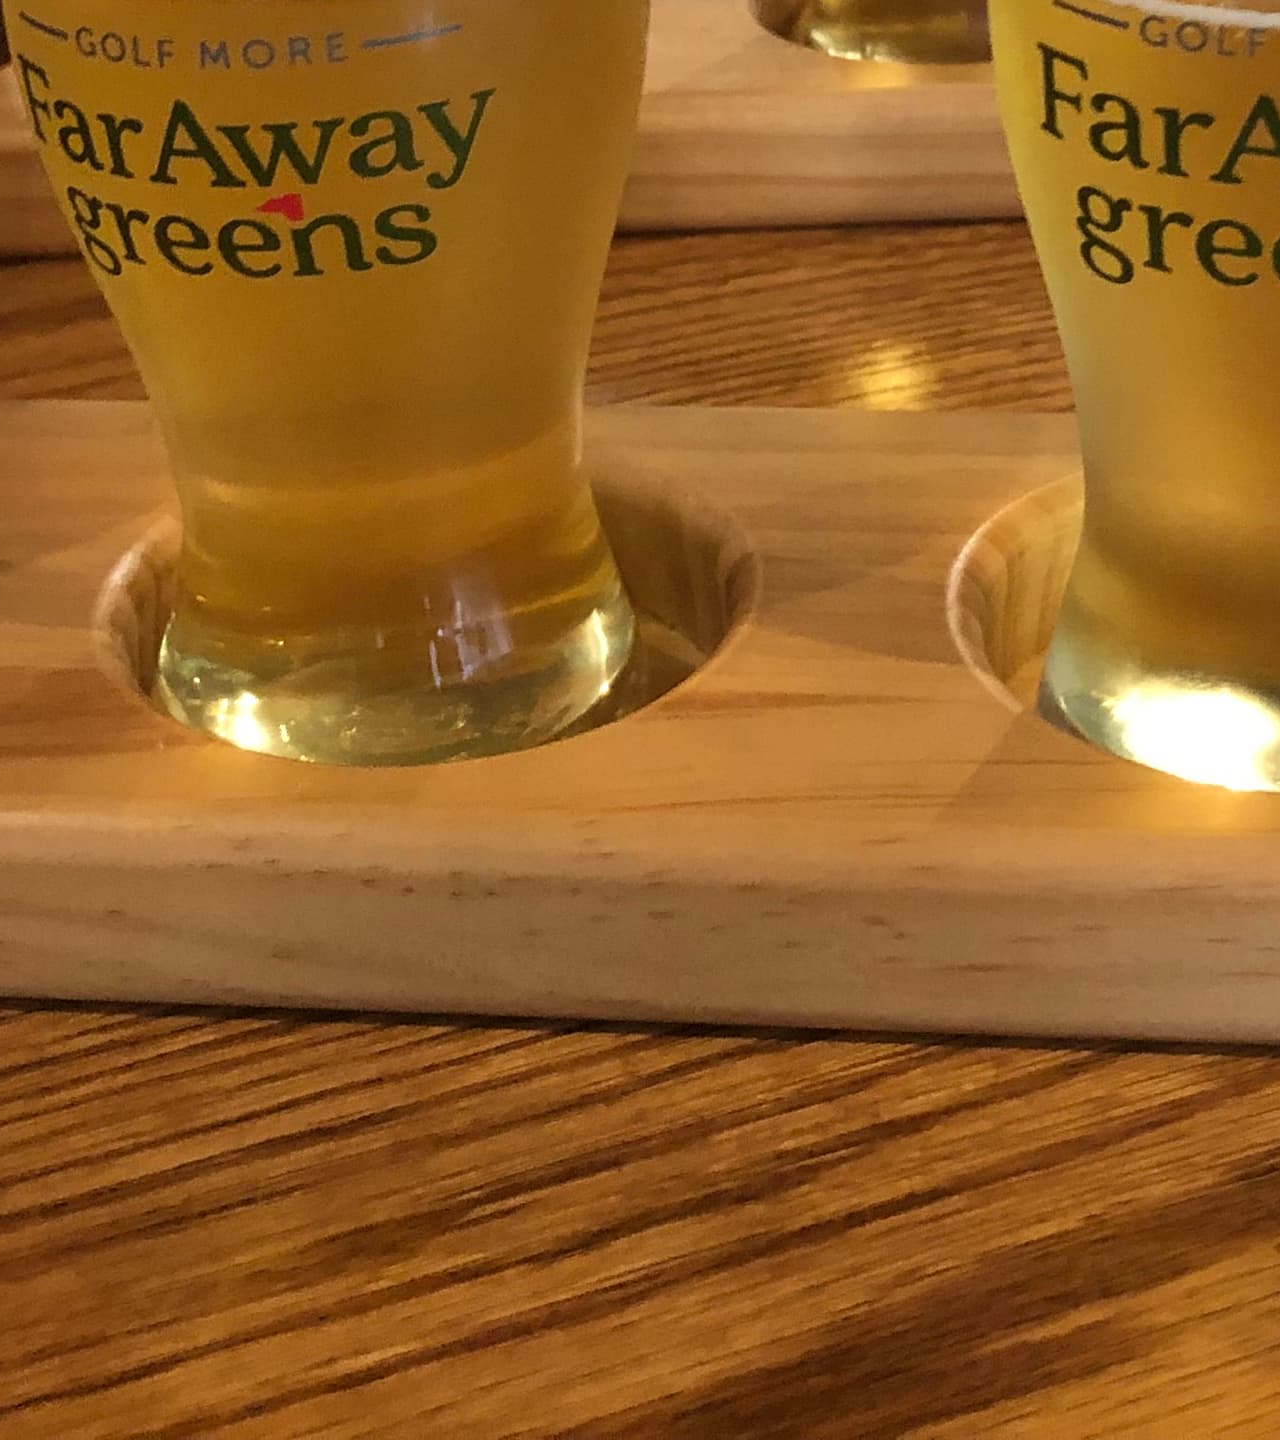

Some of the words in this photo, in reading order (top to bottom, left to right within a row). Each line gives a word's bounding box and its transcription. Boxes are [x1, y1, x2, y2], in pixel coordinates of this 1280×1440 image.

[74, 25, 175, 69] GOLF
[199, 31, 350, 71] MORE
[1137, 13, 1268, 59] GOLF
[16, 51, 498, 190] FarAway
[66, 183, 439, 279] greens
